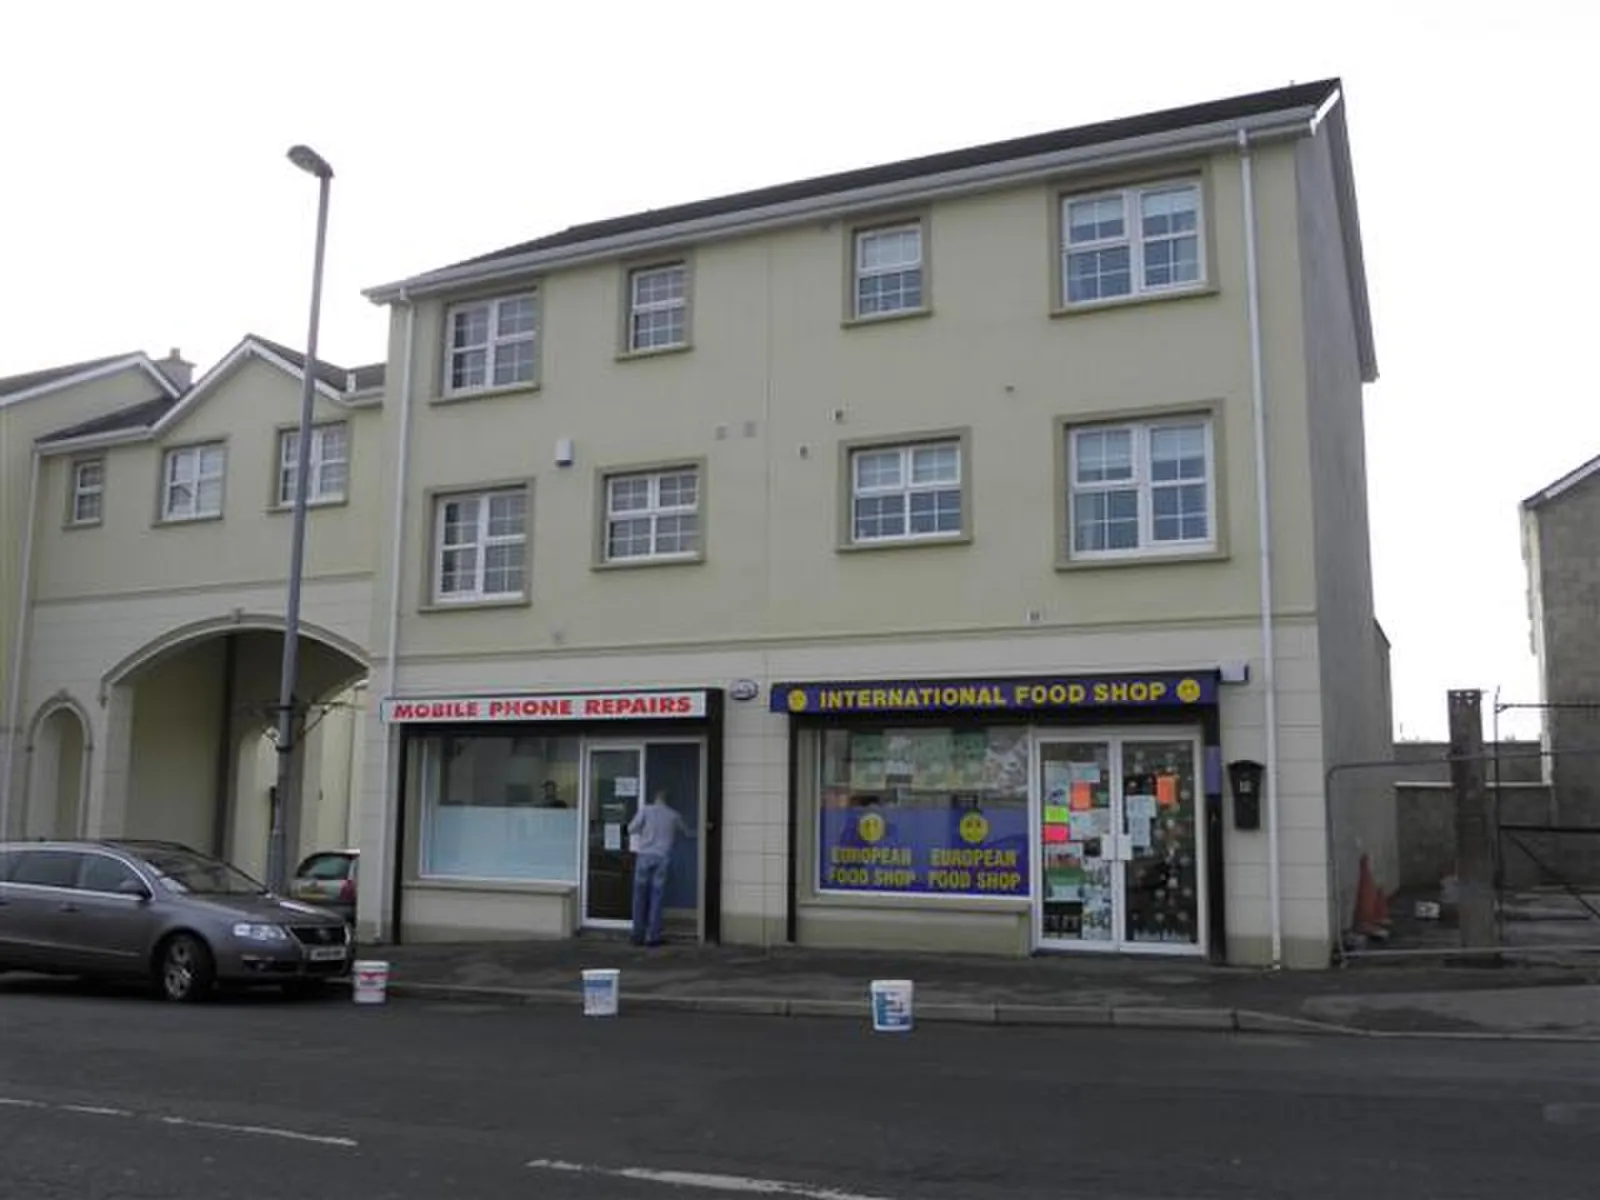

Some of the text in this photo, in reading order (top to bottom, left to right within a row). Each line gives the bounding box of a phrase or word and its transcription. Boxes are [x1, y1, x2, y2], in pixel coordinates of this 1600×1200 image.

[819, 681, 1167, 710] INTERNATIONAL FOOD SHOP
[392, 696, 693, 719] MOBILE PHONE REPAIRS
[830, 846, 912, 866] EUROPEAN
[930, 848, 1017, 868] EUROPEAN
[828, 867, 916, 888] FOOD SHOP
[927, 869, 1021, 890] FOOD SHOP
